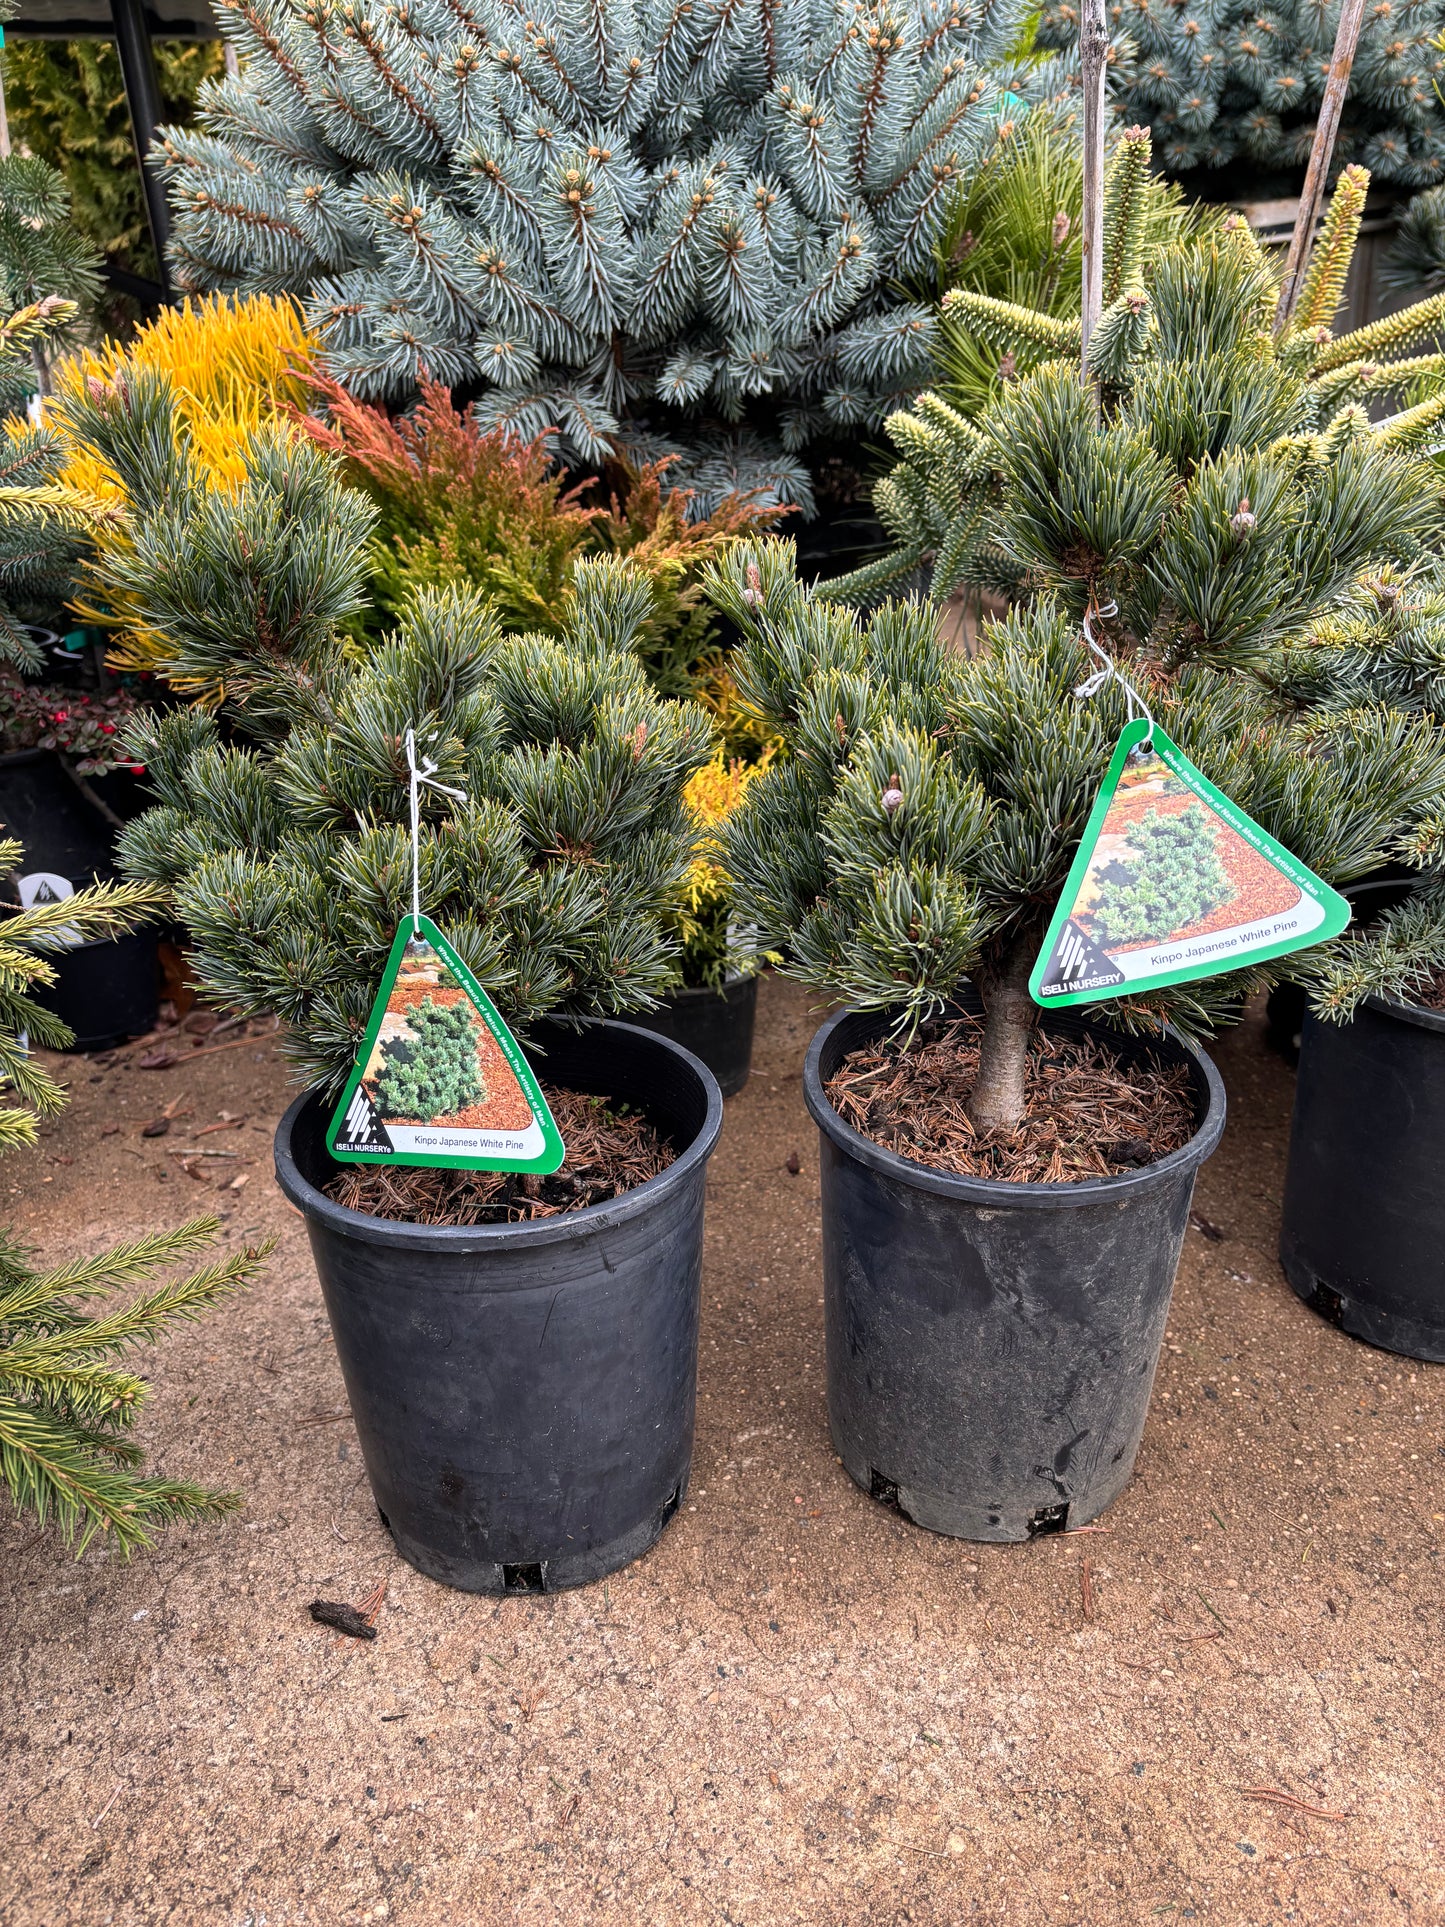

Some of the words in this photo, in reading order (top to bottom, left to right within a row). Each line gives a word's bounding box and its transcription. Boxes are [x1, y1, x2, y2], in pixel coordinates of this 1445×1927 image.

[1163, 750, 1182, 771] Where
[1182, 771, 1193, 782] the
[1192, 782, 1215, 803] Beauty
[1221, 808, 1243, 830] Nature
[1262, 844, 1274, 856] The
[1273, 856, 1297, 877] Artistry
[1304, 882, 1318, 896] Man
[1151, 950, 1183, 966] Kinpo
[1185, 937, 1238, 958] Japanese
[1239, 928, 1271, 945] White
[1273, 919, 1298, 934] Pine
[1041, 983, 1069, 996] ISELI
[1069, 972, 1121, 991] NURSERY
[454, 968, 464, 979] the
[512, 1059, 521, 1072] The
[520, 1074, 534, 1100] Artistry
[536, 1110, 546, 1126] Man
[336, 1143, 354, 1151] ISELI
[414, 1136, 437, 1146] Kinpo
[439, 1137, 478, 1148] Japanese
[480, 1138, 503, 1149] White
[506, 1140, 524, 1150] Pine
